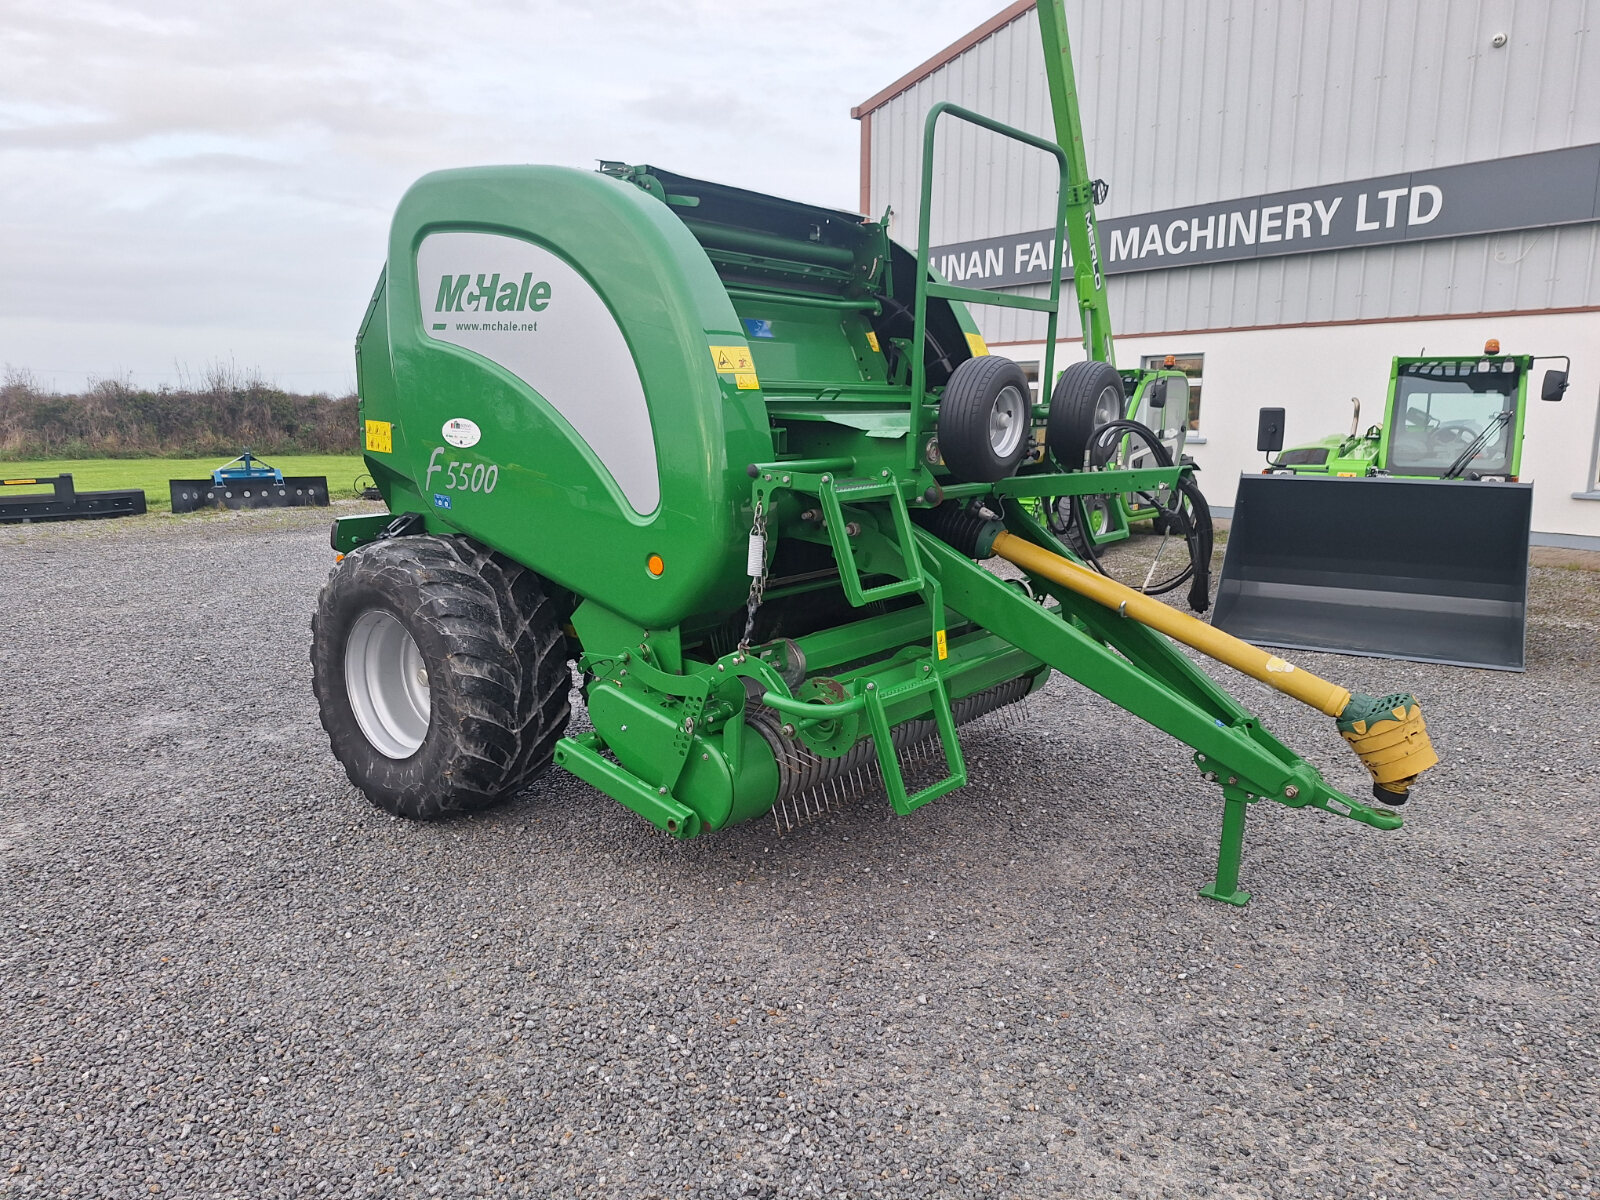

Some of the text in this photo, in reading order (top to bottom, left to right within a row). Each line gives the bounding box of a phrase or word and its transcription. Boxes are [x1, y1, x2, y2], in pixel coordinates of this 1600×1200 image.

[1015, 239, 1074, 274] FAR
[1109, 197, 1343, 262] MACHINERY
[1355, 184, 1443, 232] LTD
[1085, 211, 1102, 291] MERLO
[434, 272, 552, 312] McHale
[455, 321, 538, 332] www.mchale.net
[445, 461, 499, 494] 5500
